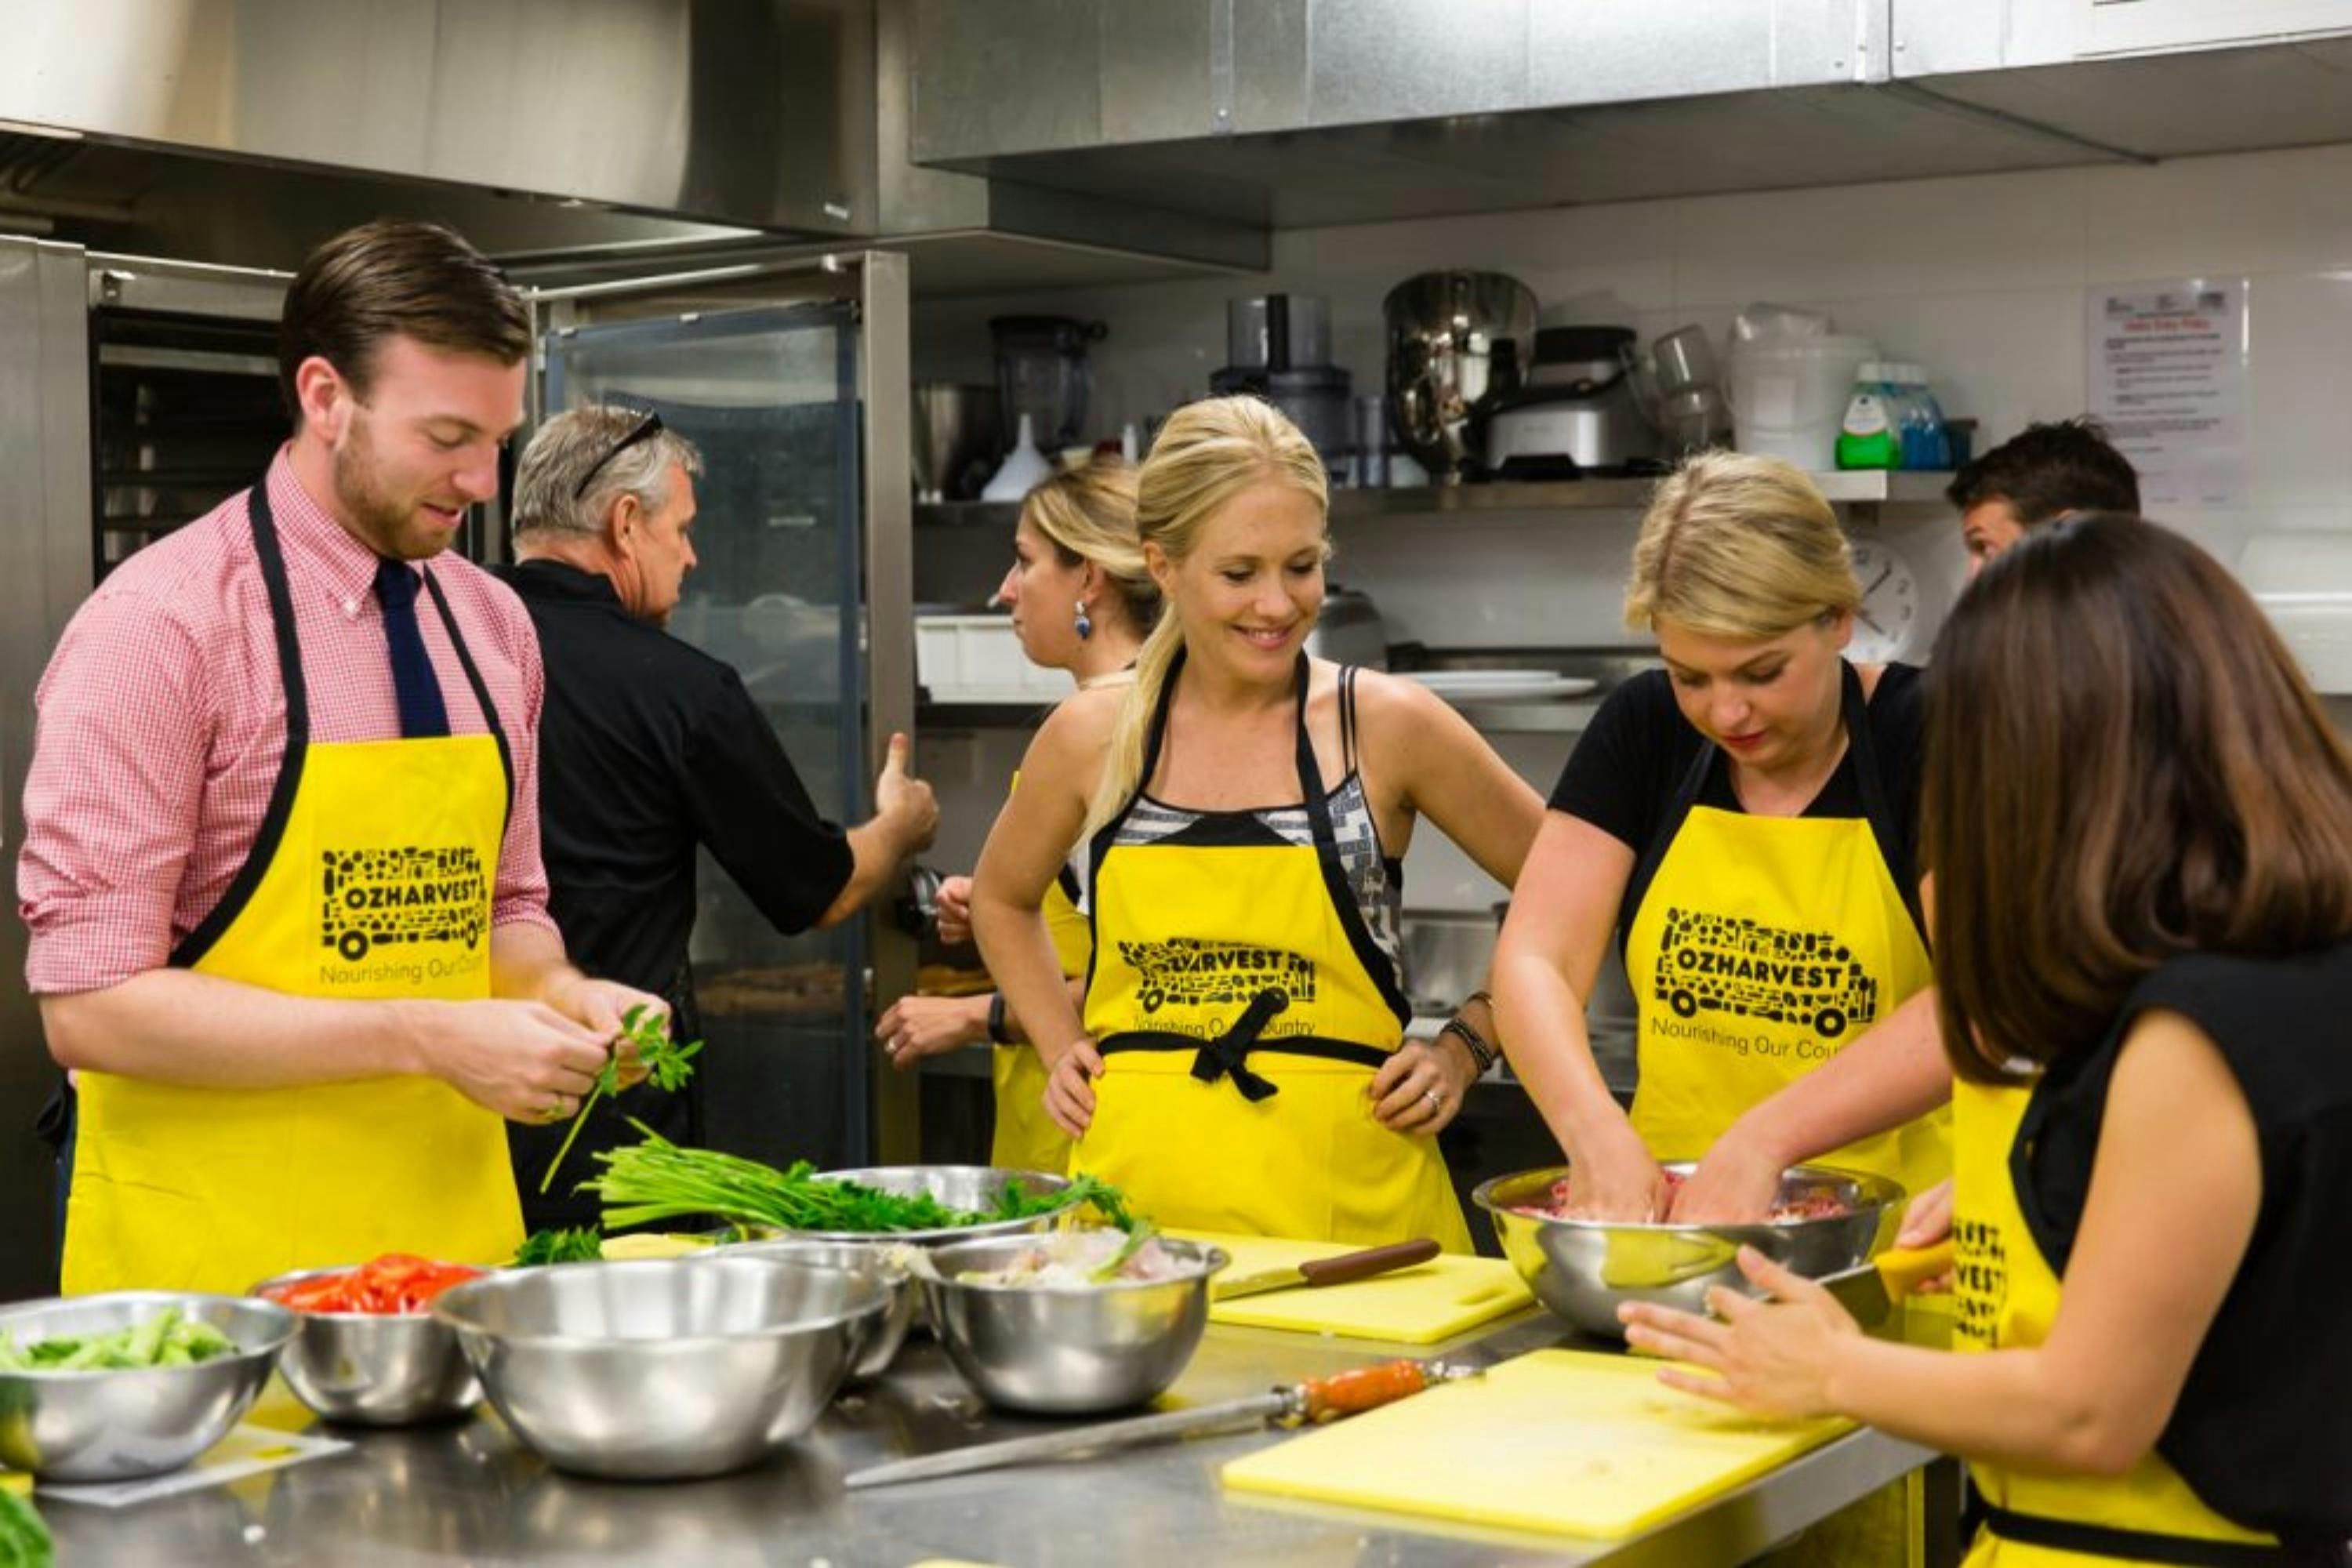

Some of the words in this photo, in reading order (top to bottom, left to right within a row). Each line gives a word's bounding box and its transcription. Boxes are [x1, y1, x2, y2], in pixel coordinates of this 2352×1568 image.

[346, 879, 477, 909] OZHARVEST
[320, 960, 423, 984] Nourishing
[1677, 948, 1842, 989] OZHARVEST
[1652, 1017, 1748, 1055] Nourishing
[1755, 1035, 1788, 1057] Our
